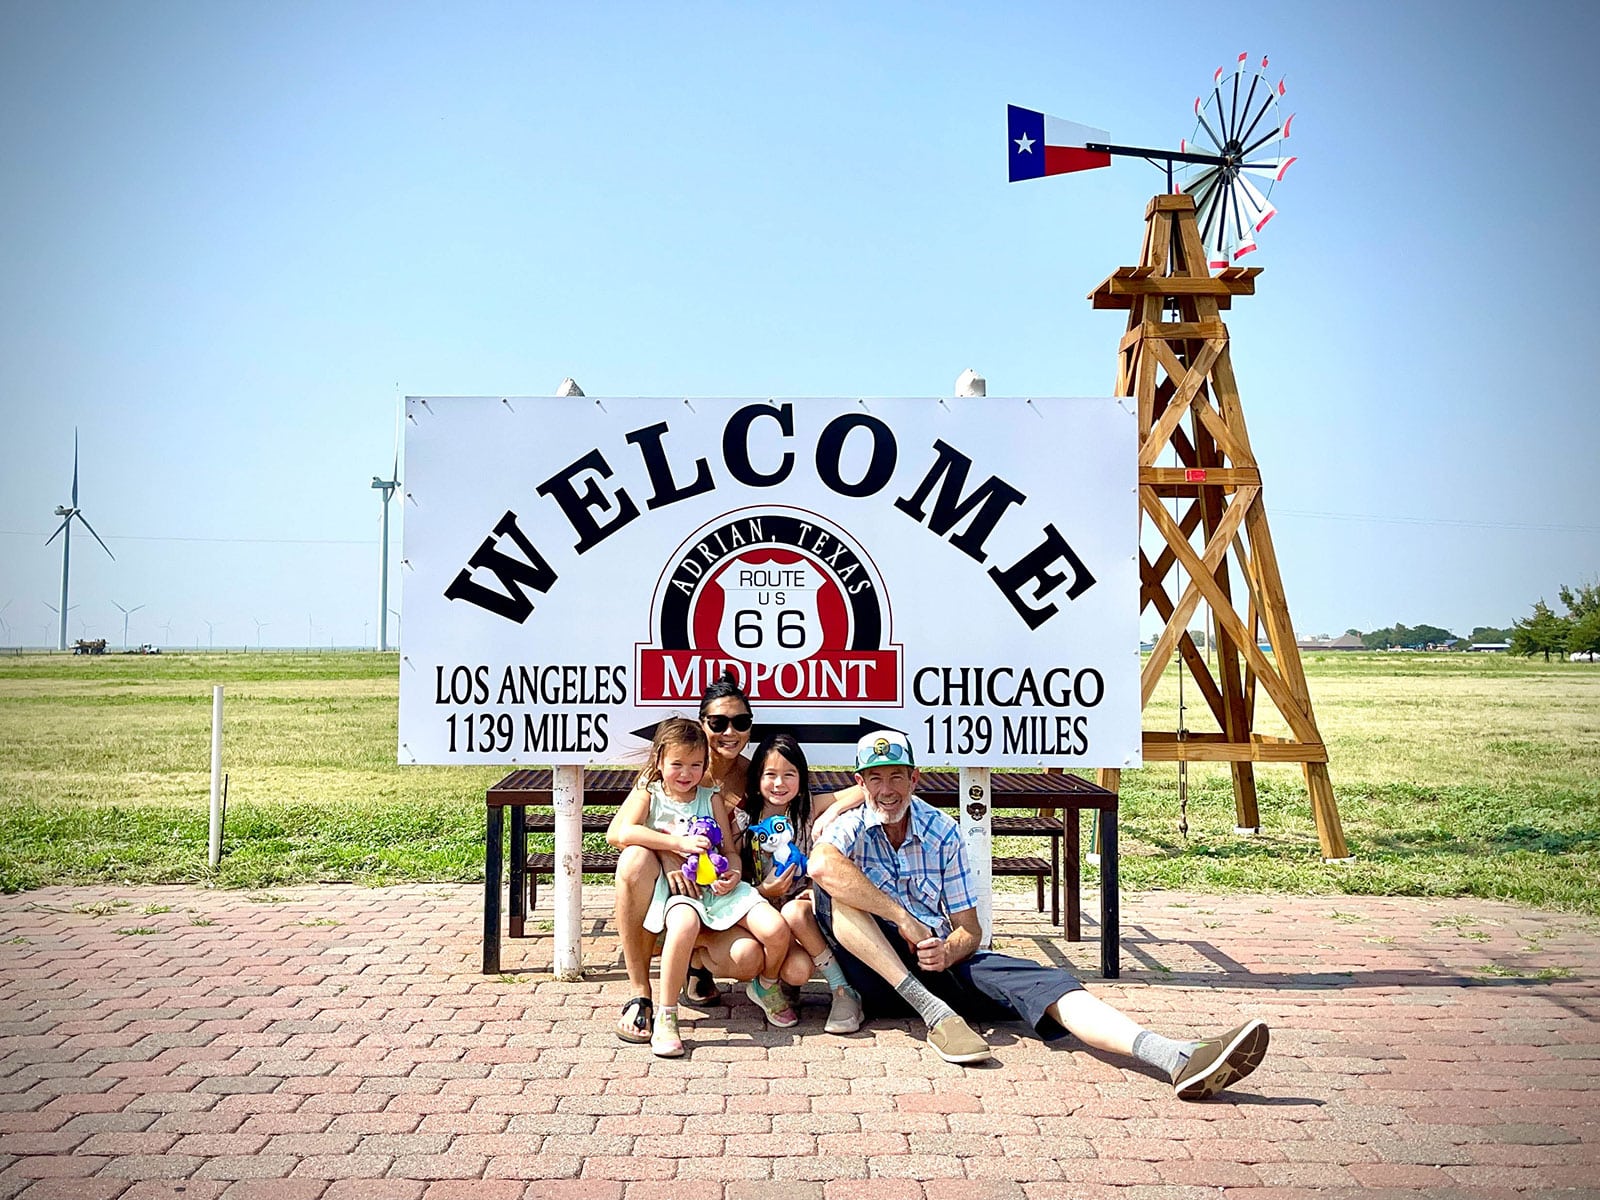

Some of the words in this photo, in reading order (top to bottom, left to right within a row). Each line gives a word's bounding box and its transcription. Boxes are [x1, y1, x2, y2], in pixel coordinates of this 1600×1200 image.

[444, 403, 1096, 632] WELCOME
[671, 518, 777, 596] ADRIAN,
[797, 522, 872, 595] TEXAS
[740, 570, 806, 587] ROUTE
[734, 609, 806, 649] 66
[436, 665, 490, 705] LOS
[496, 666, 627, 706] ANGELES
[912, 666, 1105, 708] CHICAGO
[446, 713, 514, 753] 1139
[523, 713, 609, 753] MILES
[924, 714, 993, 755] 1139
[1002, 714, 1089, 756] MILES
